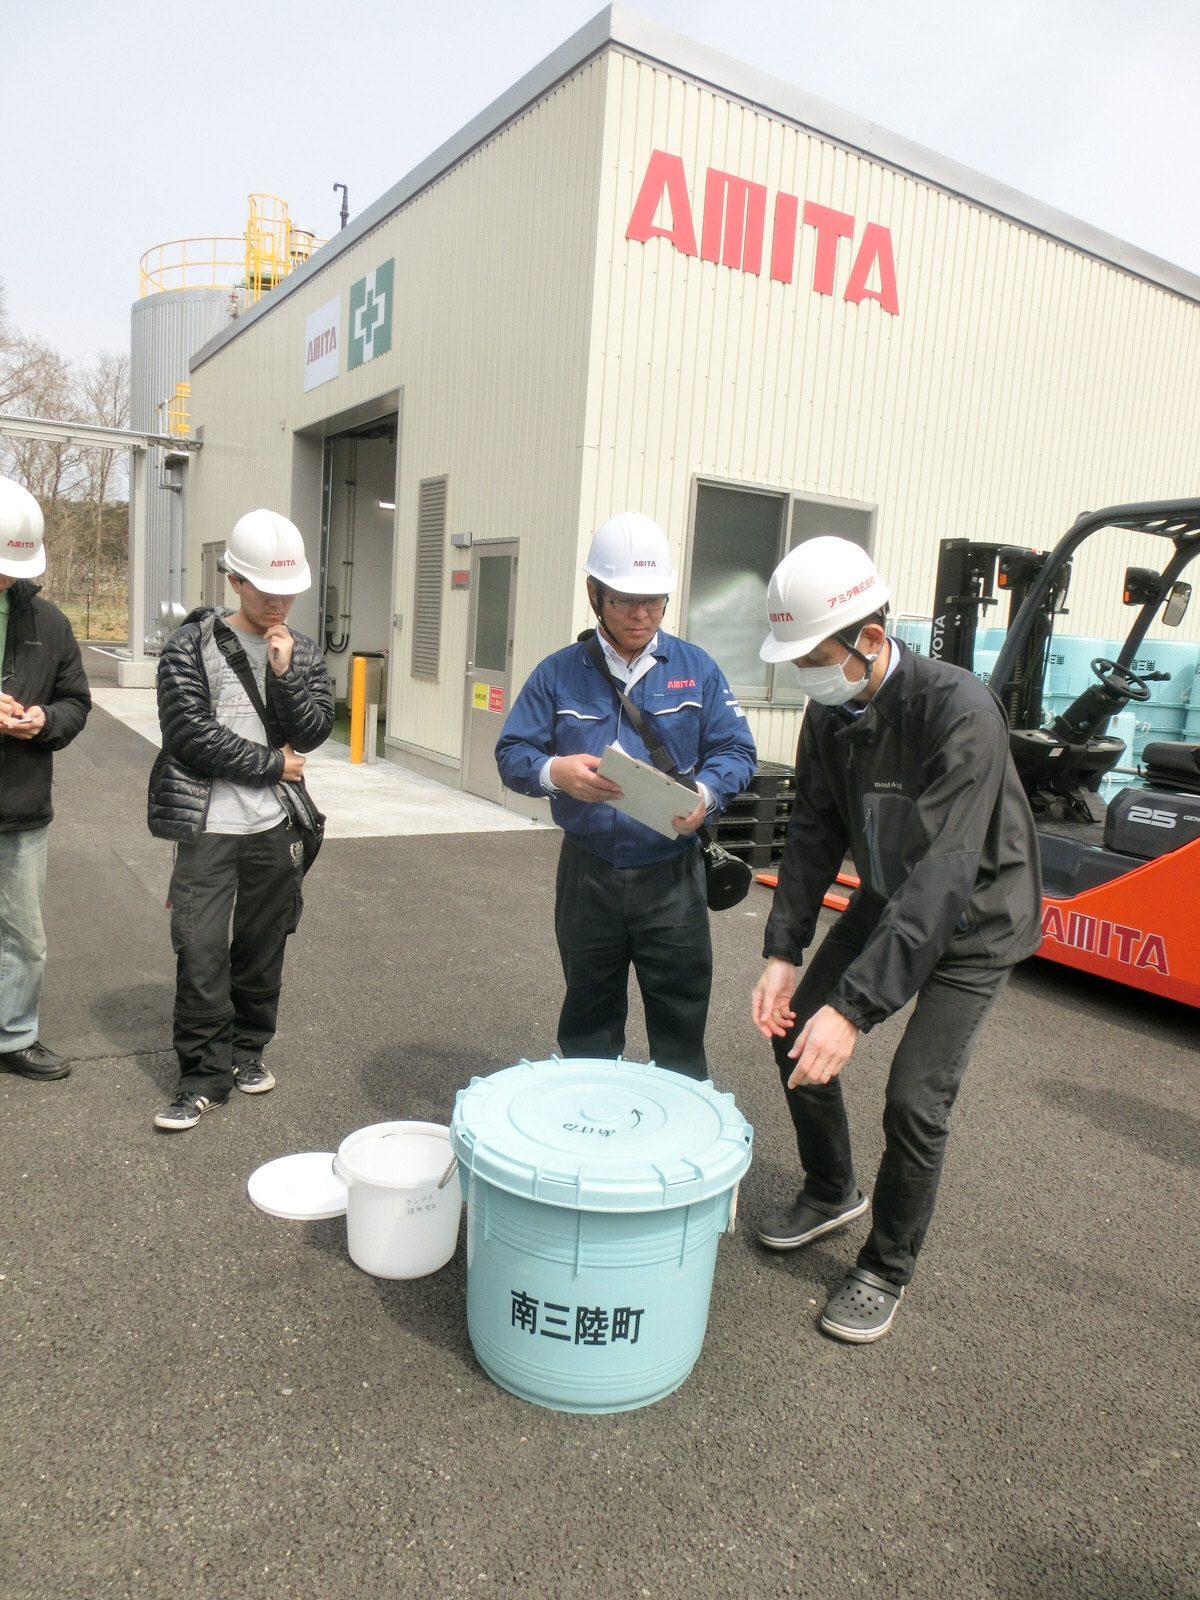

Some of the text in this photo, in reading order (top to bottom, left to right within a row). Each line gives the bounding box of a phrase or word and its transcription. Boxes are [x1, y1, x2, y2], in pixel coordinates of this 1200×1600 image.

[625, 148, 900, 316] AMITA
[306, 325, 337, 366] AMITA
[7, 540, 35, 549] AMITA
[270, 559, 296, 568] AMITA
[633, 560, 656, 568] AMITA
[827, 576, 876, 608] アミタ株式会社
[667, 679, 696, 689] AMITA
[1127, 805, 1178, 829] 25
[1041, 904, 1169, 976] AMITA
[510, 1290, 645, 1346] 南三陸町
